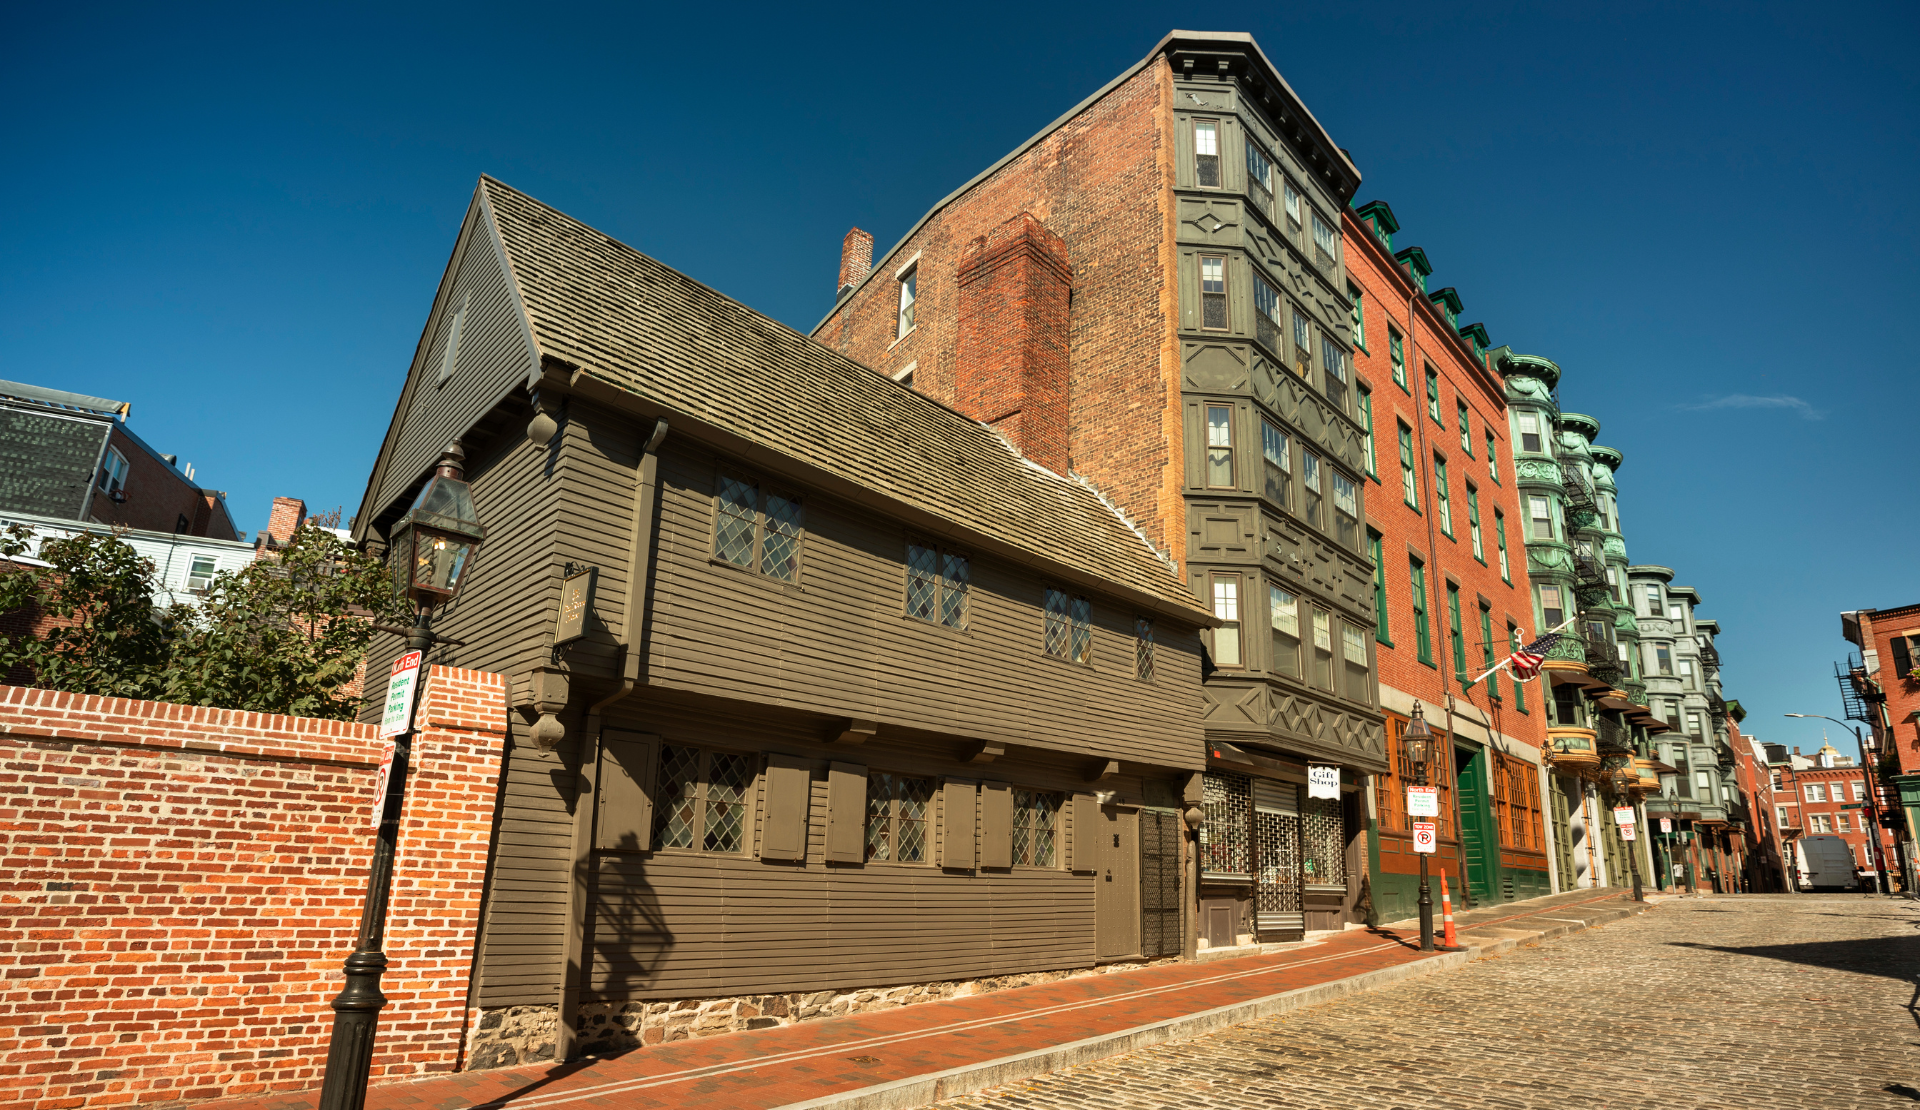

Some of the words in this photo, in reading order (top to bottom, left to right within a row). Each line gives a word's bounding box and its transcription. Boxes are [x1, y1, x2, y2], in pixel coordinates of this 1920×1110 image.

[405, 655, 418, 668] End
[391, 677, 409, 689] Resident
[391, 689, 405, 701] Permit
[388, 702, 404, 714] Parking
[1313, 771, 1334, 779] Gift
[1310, 778, 1338, 787] Shop
